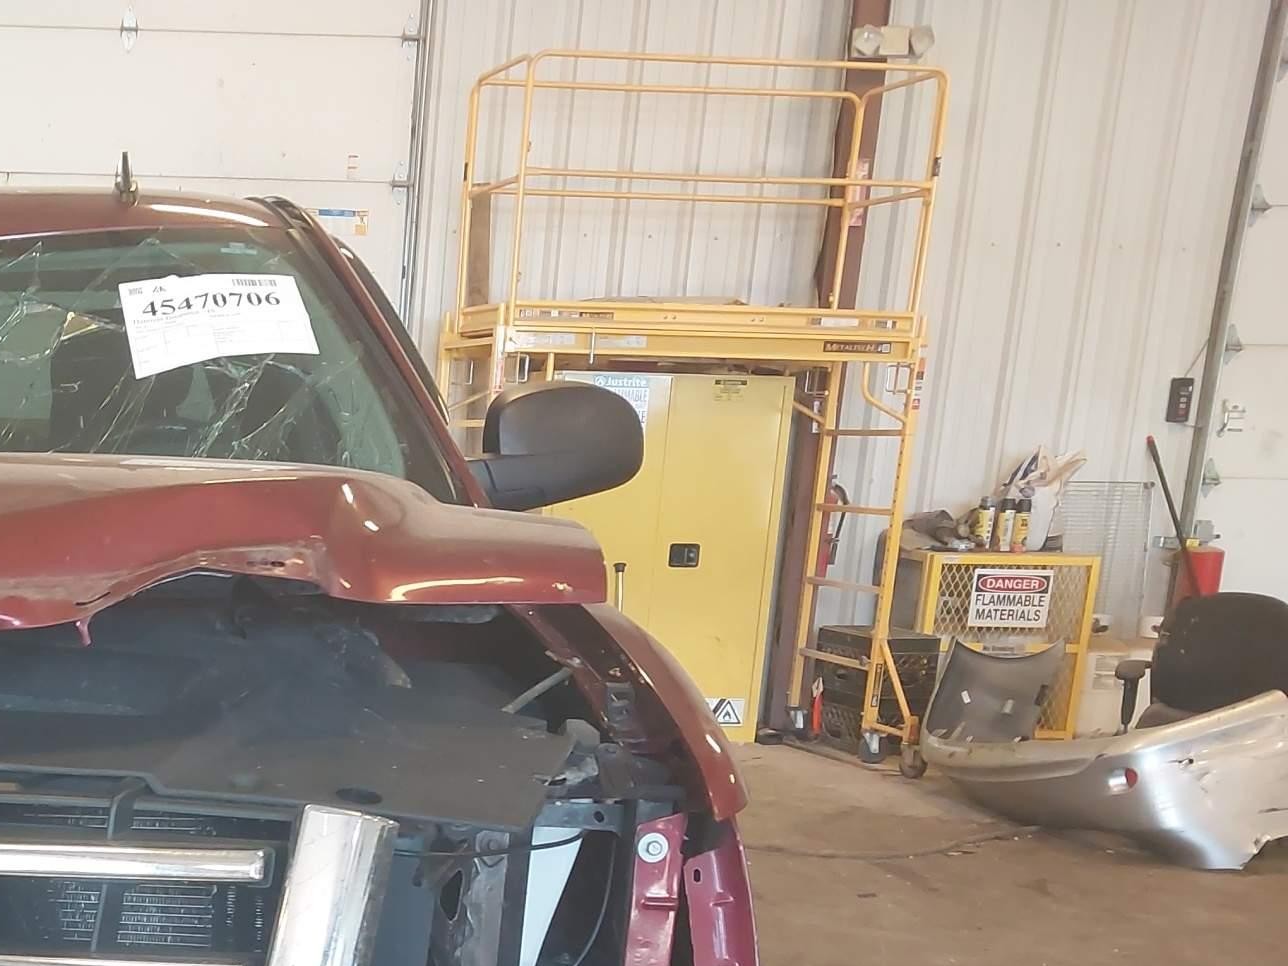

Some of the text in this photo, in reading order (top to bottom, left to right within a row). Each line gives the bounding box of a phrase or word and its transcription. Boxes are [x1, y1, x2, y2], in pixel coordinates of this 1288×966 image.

[142, 291, 281, 317] 45470706
[606, 376, 647, 387] Justrite
[986, 578, 1040, 590] DANGER
[975, 594, 1046, 608] FLAMMABLE
[975, 608, 1041, 622] MATERIALS
